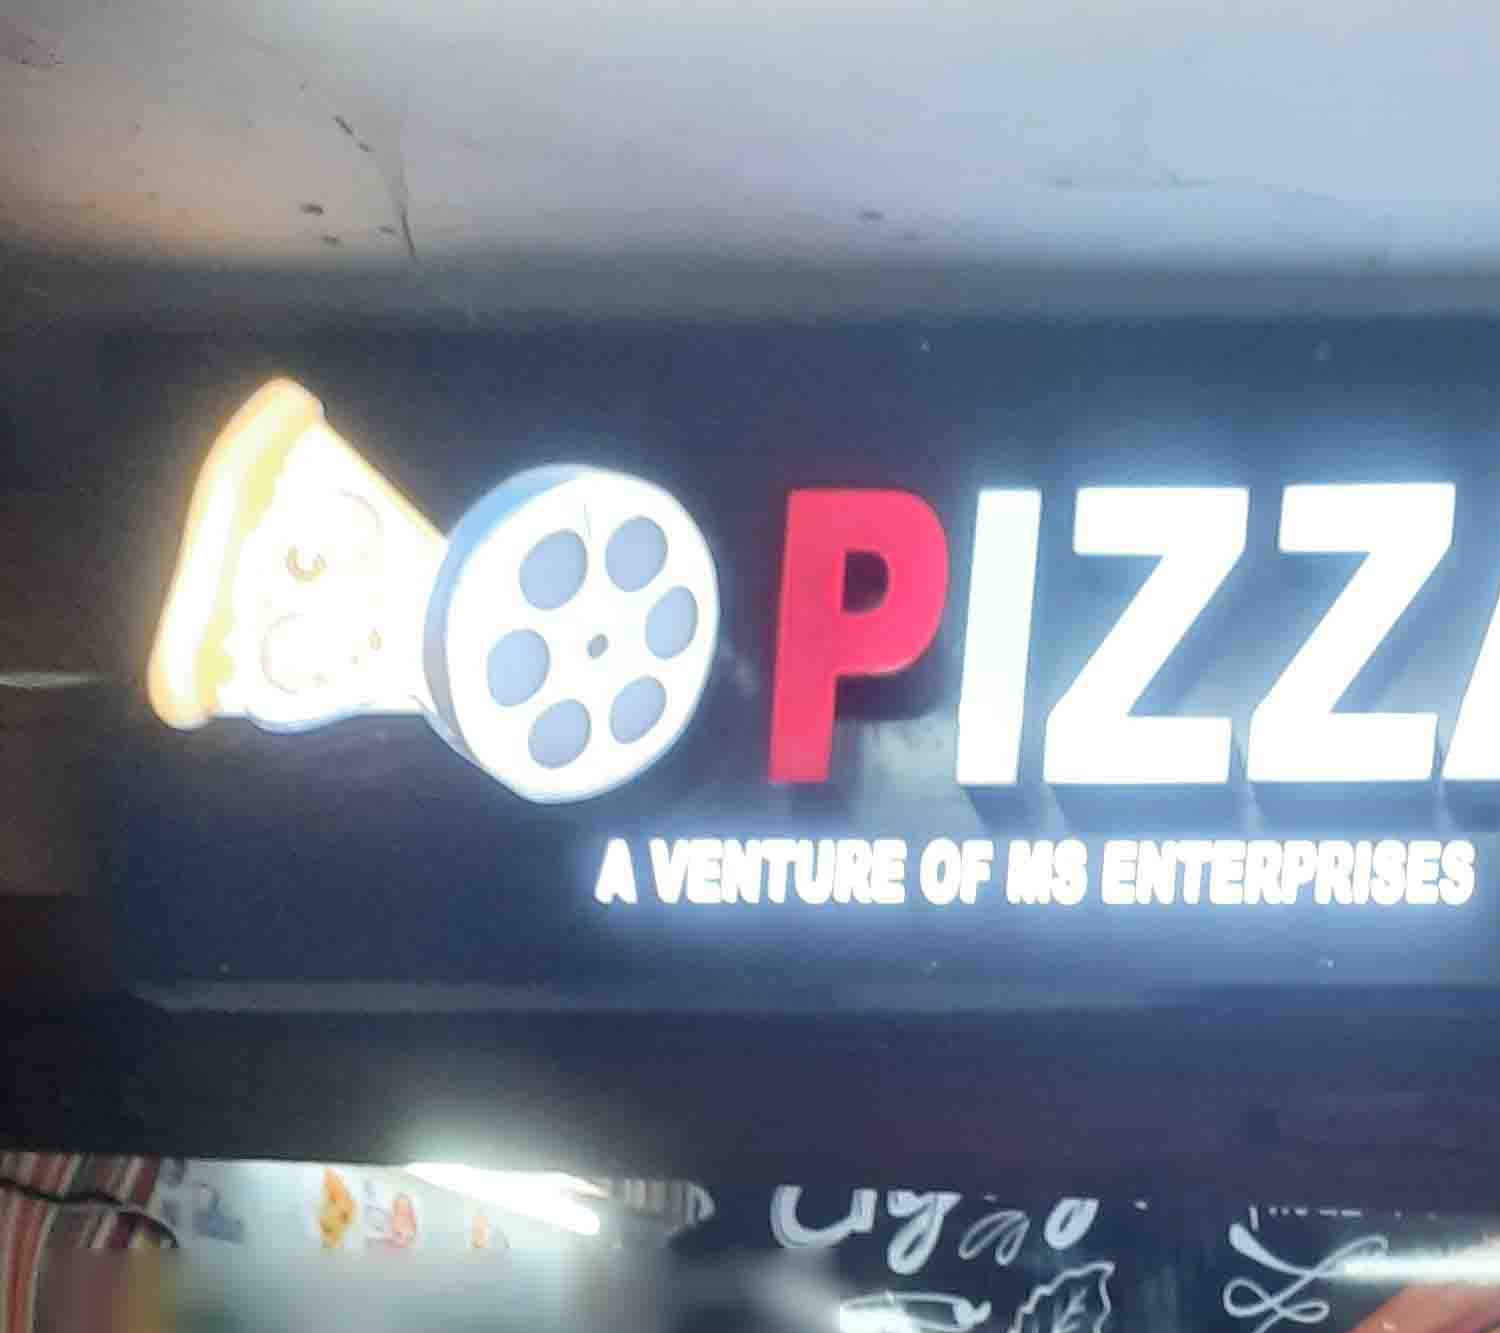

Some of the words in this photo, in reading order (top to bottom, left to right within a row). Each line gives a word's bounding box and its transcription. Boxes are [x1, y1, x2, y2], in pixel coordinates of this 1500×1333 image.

[596, 838, 638, 903] A
[651, 838, 906, 904] VENTURE
[920, 838, 994, 904] OF
[1006, 838, 1088, 904] MS
[1101, 837, 1477, 905] ENTERPRISES
